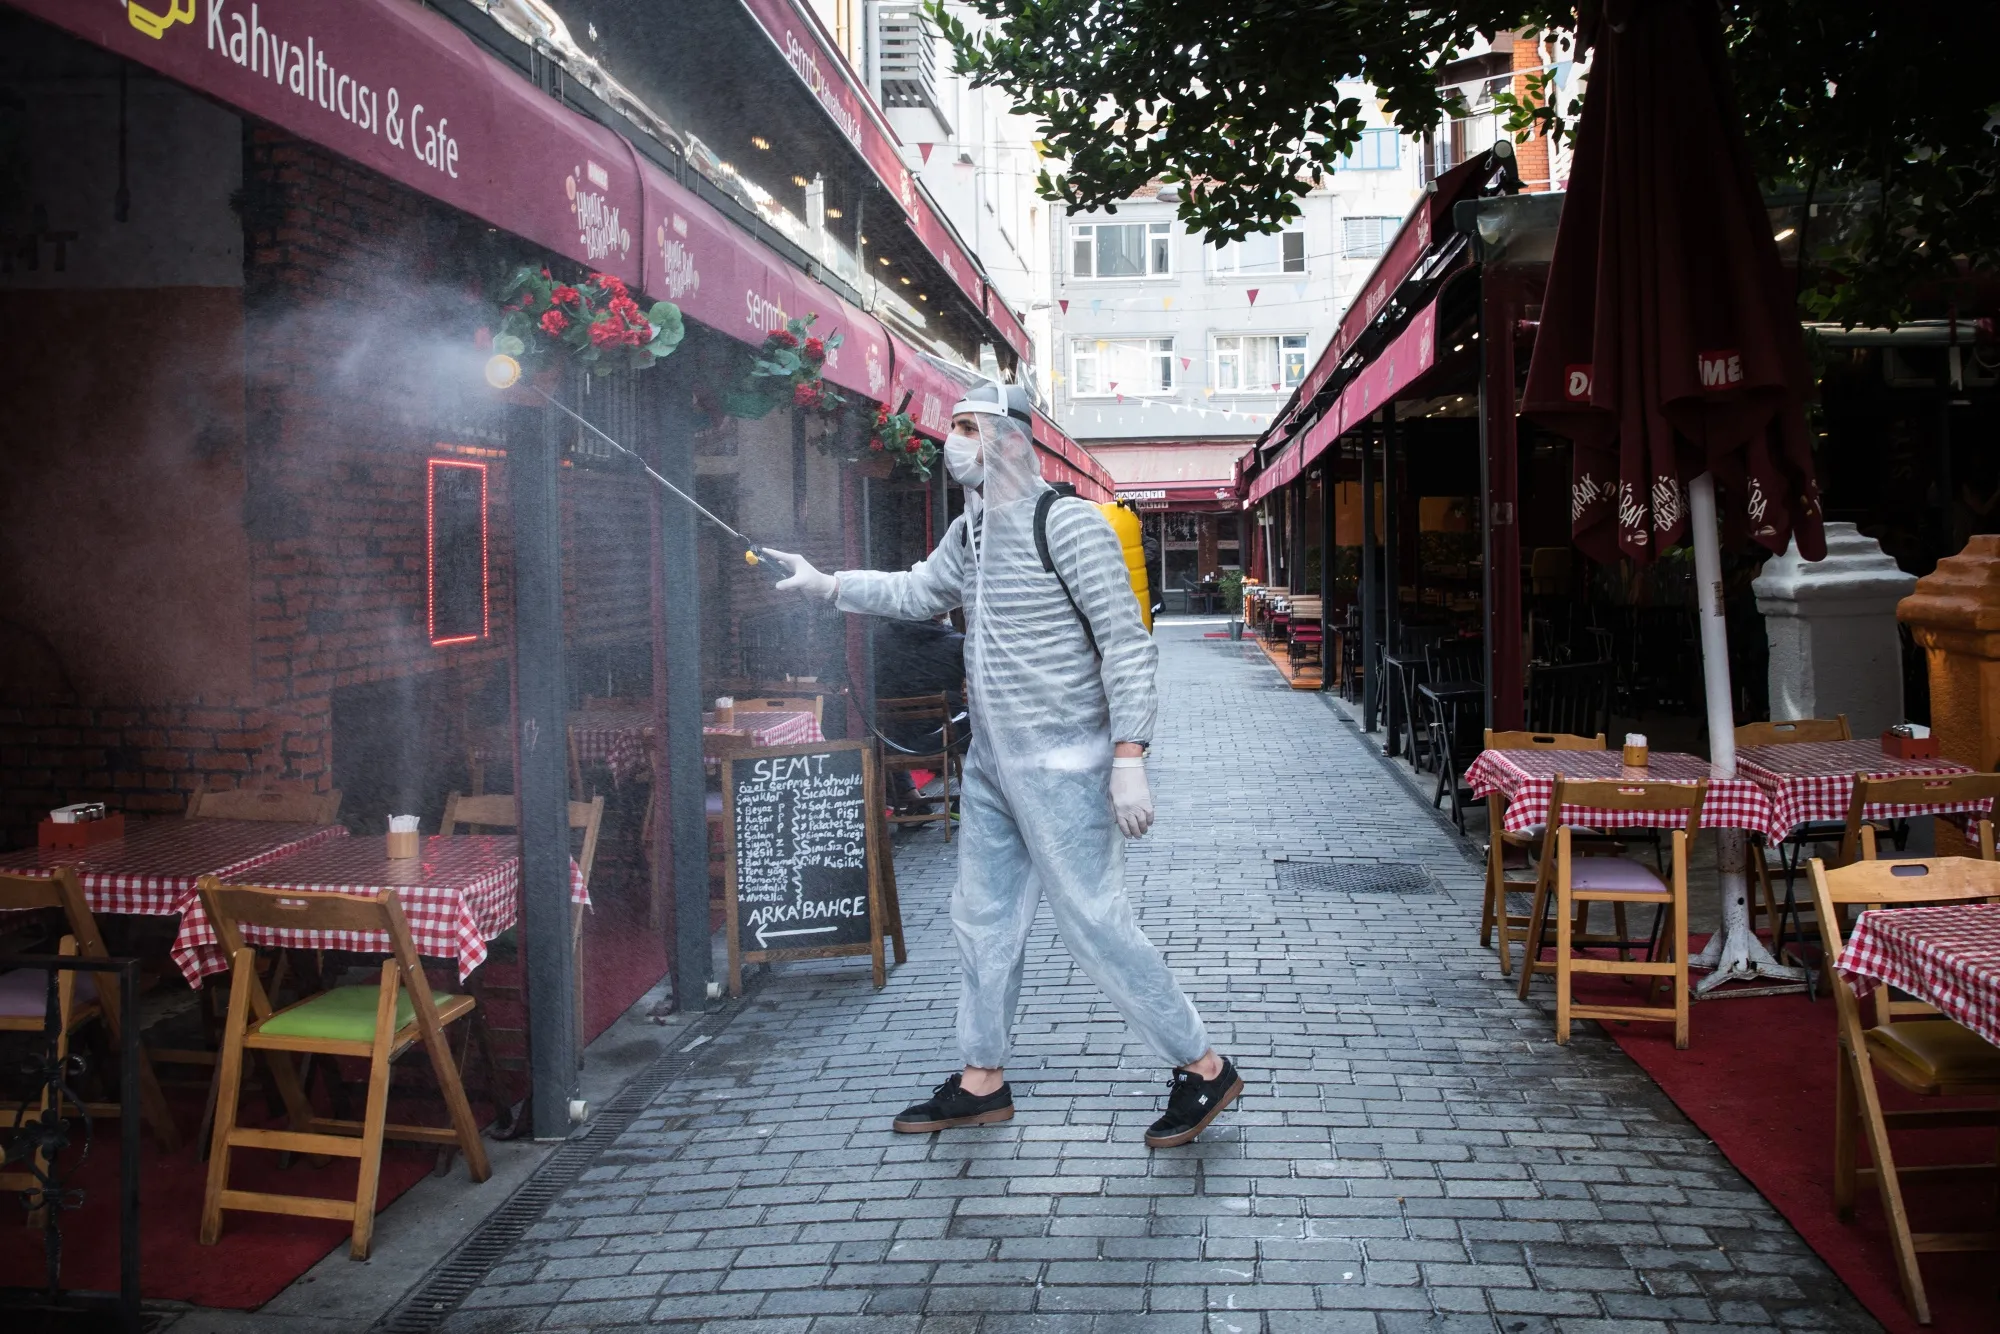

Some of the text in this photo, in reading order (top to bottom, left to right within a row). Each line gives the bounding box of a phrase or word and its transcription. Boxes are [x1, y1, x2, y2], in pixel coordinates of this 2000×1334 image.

[386, 87, 404, 150] &
[411, 104, 458, 178] Cafe
[1619, 494, 1648, 528] BAK
[1748, 489, 1768, 522] BA
[752, 754, 831, 782] SEMT
[747, 896, 866, 926] ARKA BAHÇE
